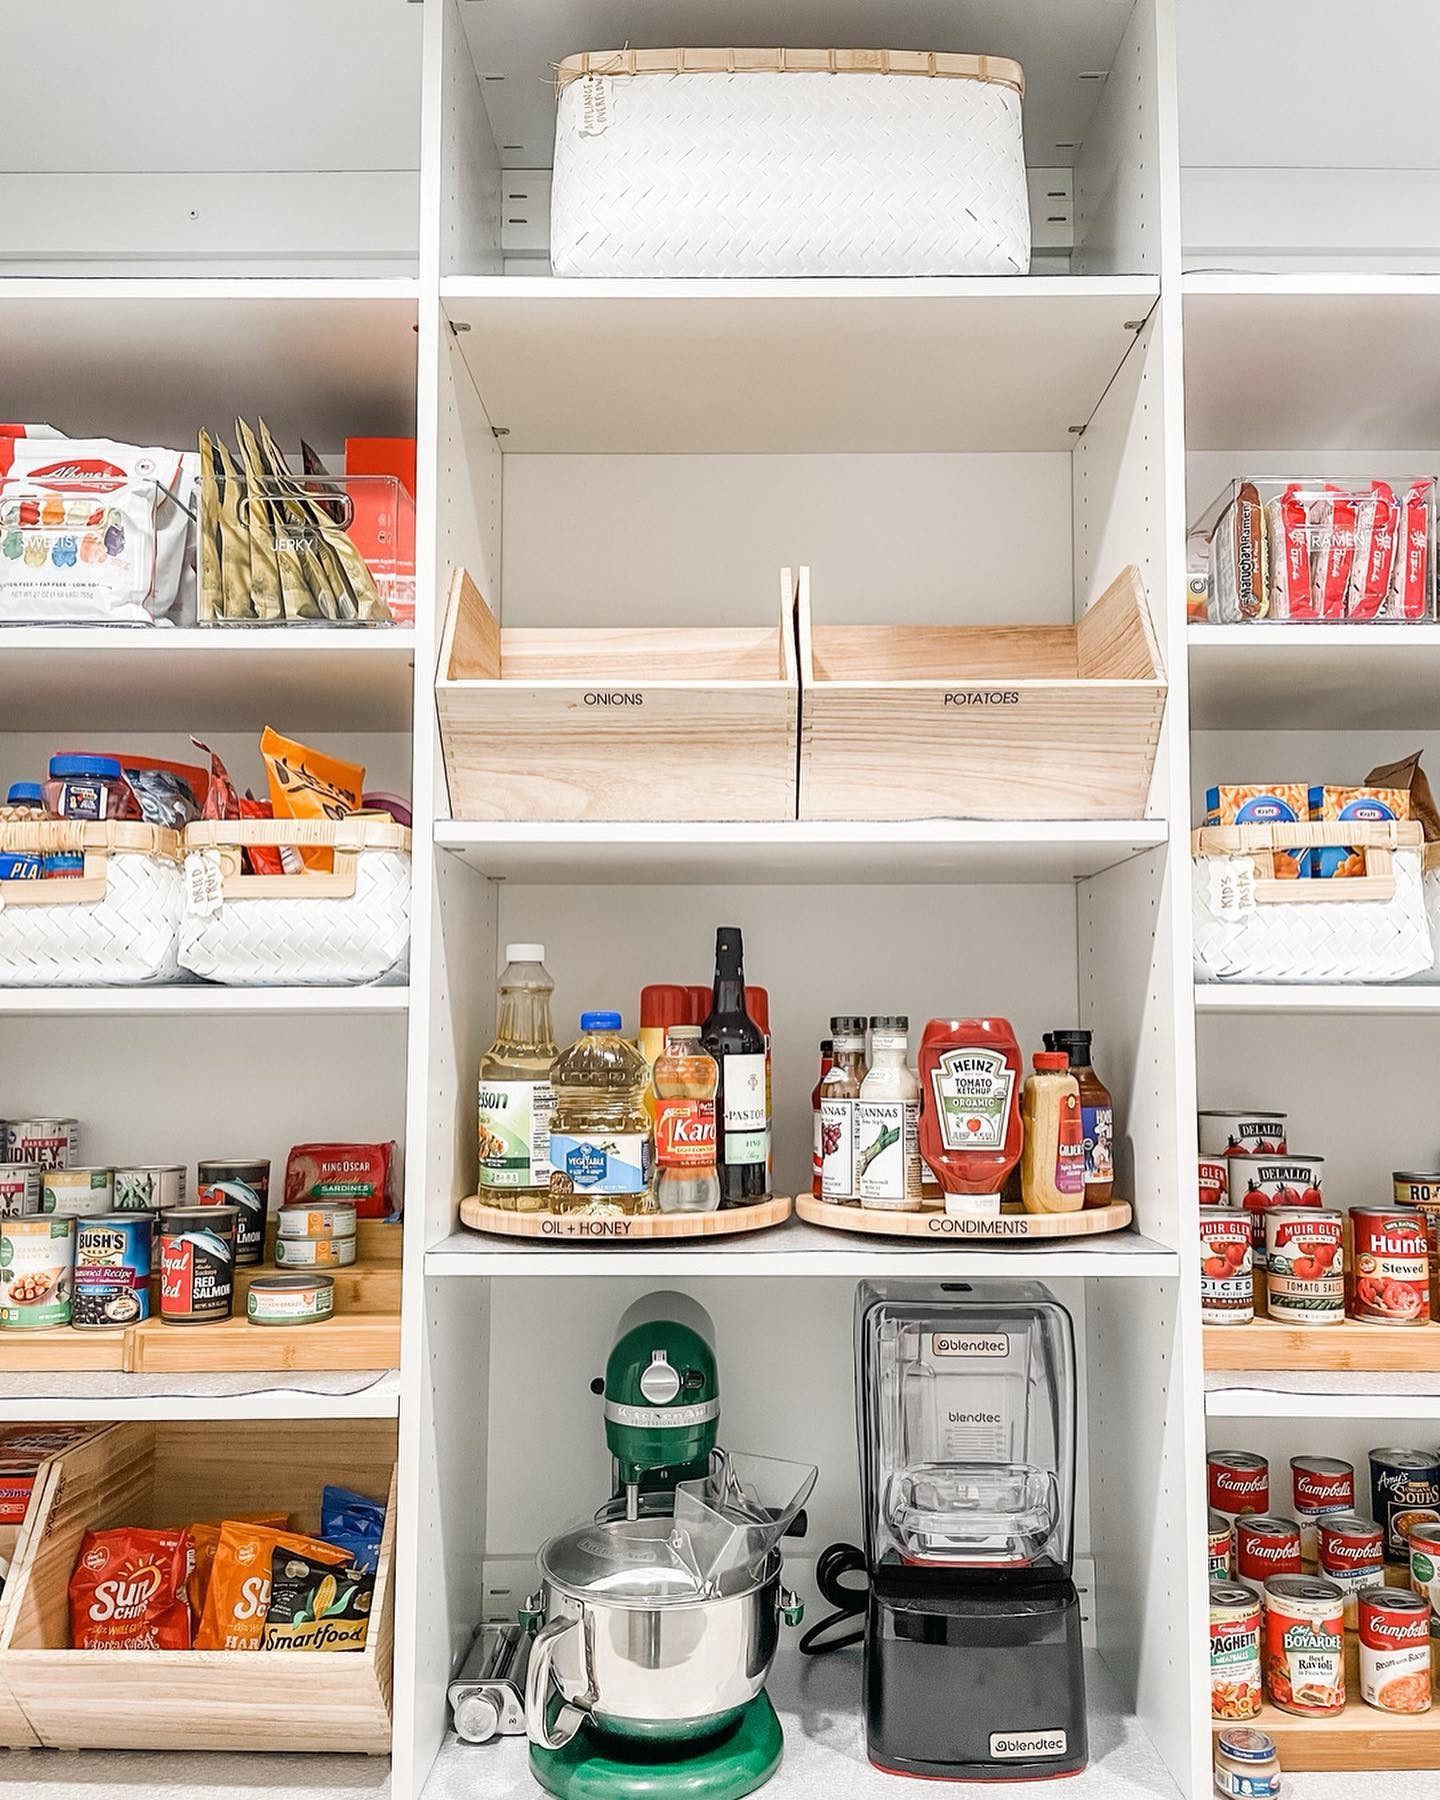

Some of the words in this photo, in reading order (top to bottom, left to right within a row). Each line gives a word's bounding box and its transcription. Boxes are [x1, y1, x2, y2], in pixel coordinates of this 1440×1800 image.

[271, 539, 313, 552] JERKY
[1312, 536, 1367, 547] RAMEN
[583, 693, 643, 706] ONIONS
[944, 692, 1019, 706] POTATOES
[1257, 808, 1275, 816] Kraft
[1360, 810, 1377, 818] Kraft
[192, 869, 204, 904] DRIED
[953, 1059, 994, 1073] HEINZ
[955, 1078, 993, 1088] TOMATO
[957, 1087, 992, 1095] KETCHUP
[952, 1098, 995, 1107] ORGANIC
[1242, 1125, 1282, 1136] DELALLO
[40, 1161, 64, 1172] ANS
[322, 1162, 342, 1172] KING
[343, 1161, 370, 1172] OSCAR
[1262, 1168, 1309, 1181] DELALLO
[541, 1221, 563, 1234] OIL
[579, 1221, 632, 1235] HONEY
[928, 1219, 1028, 1234] CONDIMENTS
[1284, 1223, 1316, 1235] MUIR
[80, 1234, 124, 1250] BUSH'S
[237, 1231, 261, 1244] LMON
[103, 1268, 132, 1278] Recipe
[1382, 1263, 1424, 1273] Stewed
[194, 1276, 215, 1288] RED
[1286, 1281, 1319, 1293] TOMATO
[193, 1284, 231, 1300] SALMON
[950, 1339, 1005, 1351] blendtec
[949, 1411, 1001, 1423] blendtec
[1377, 1470, 1409, 1491] Amy's
[1343, 1587, 1359, 1596] cho
[113, 1603, 148, 1620] CHIP
[265, 1624, 364, 1650] Smartfood
[1290, 1625, 1311, 1637] Chef
[1284, 1634, 1342, 1650] BOYARDEE
[1298, 1658, 1333, 1671] Ravioli
[1375, 1659, 1396, 1672] Bean
[1007, 1738, 1063, 1752] blendtec
